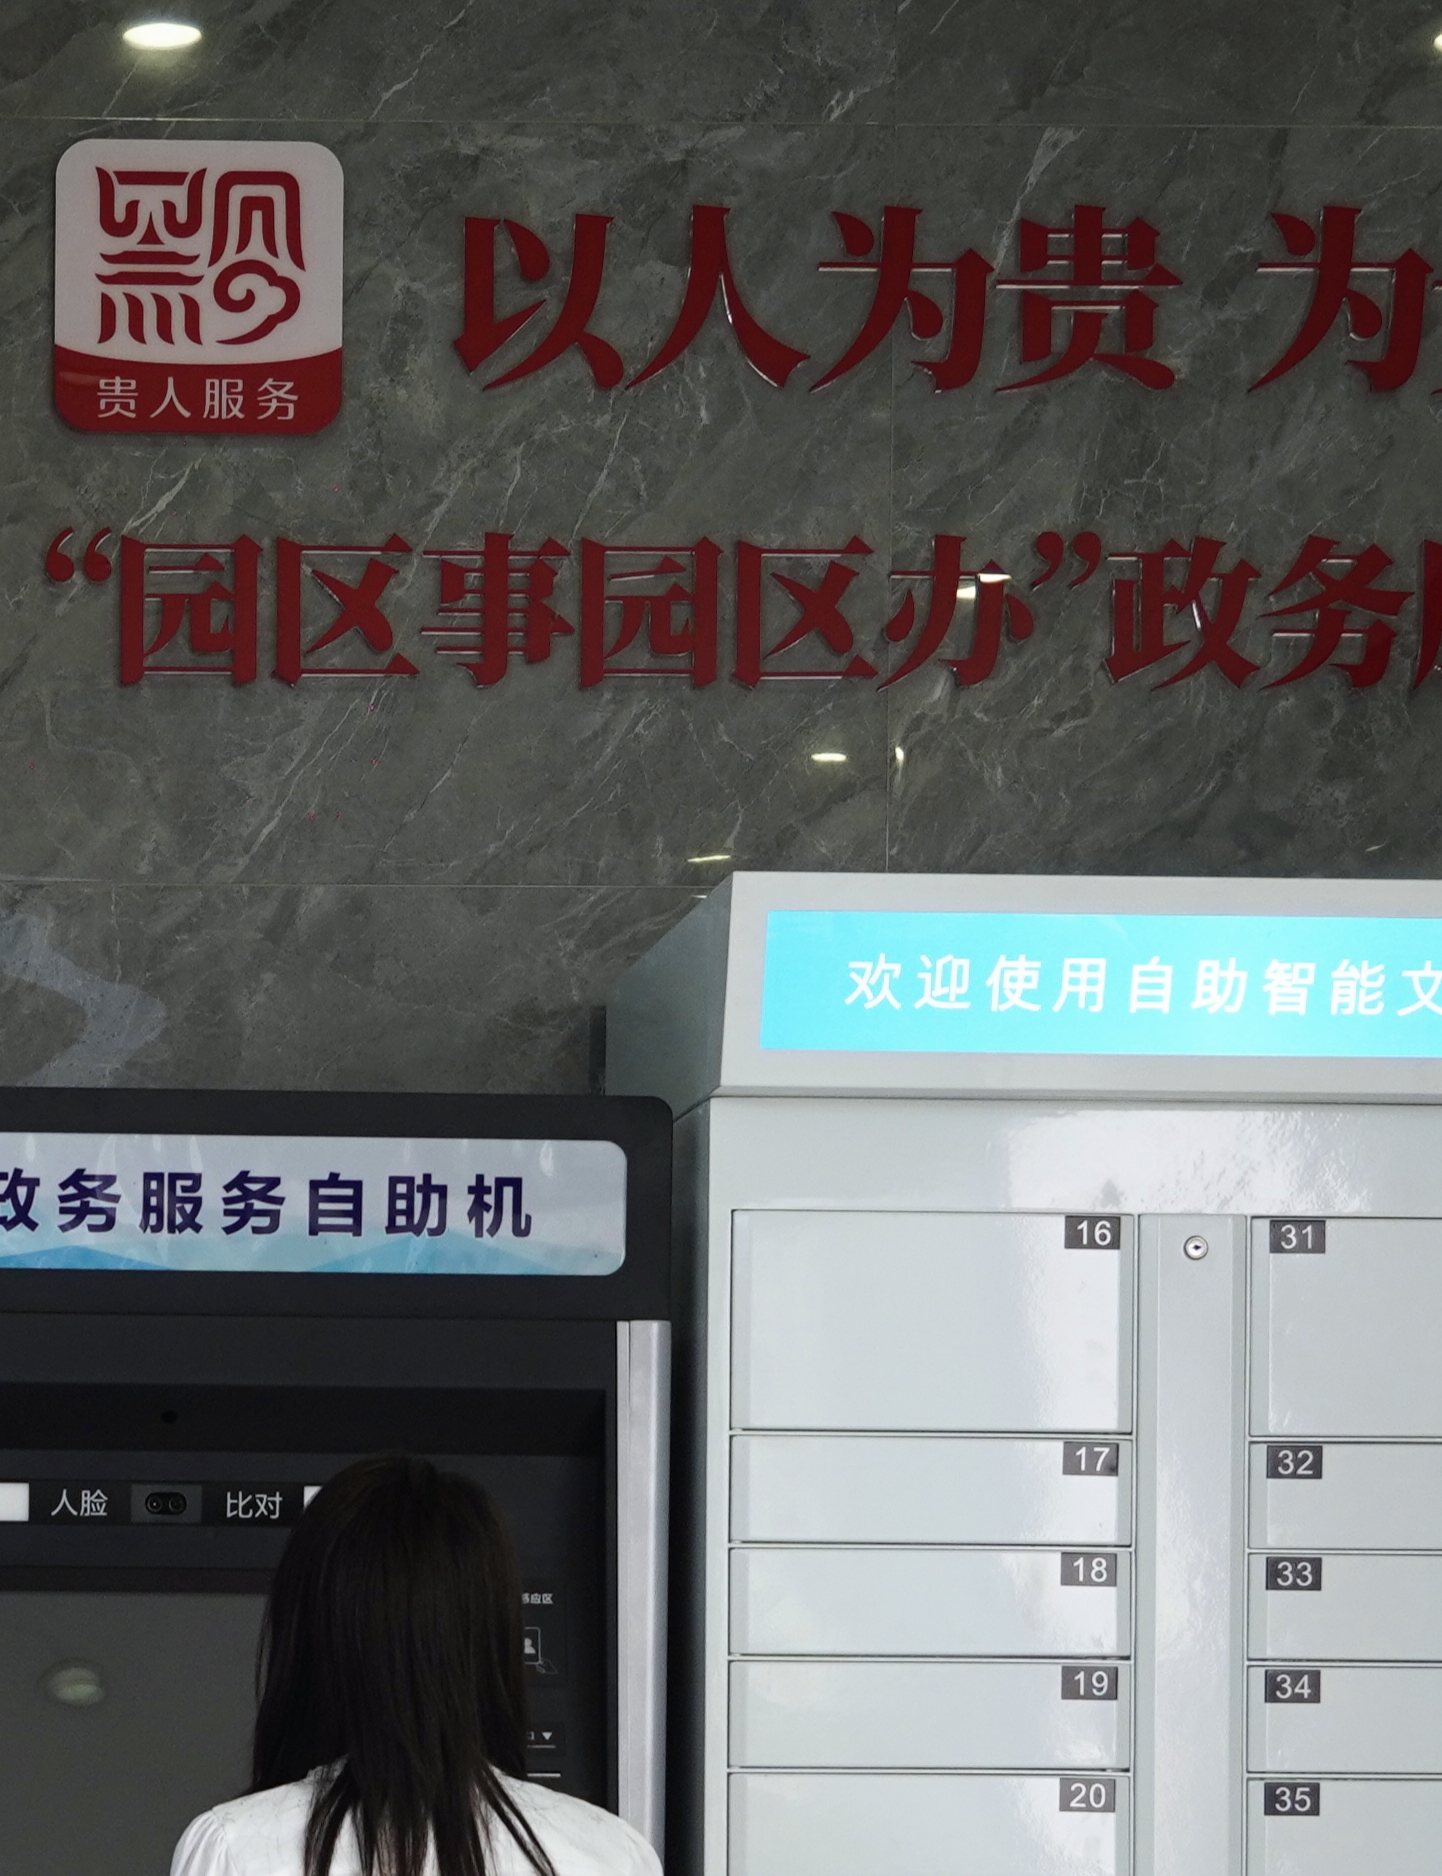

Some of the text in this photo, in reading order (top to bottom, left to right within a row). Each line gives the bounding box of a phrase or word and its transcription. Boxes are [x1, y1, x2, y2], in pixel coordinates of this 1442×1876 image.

[452, 204, 1183, 394] 以人为贵
[96, 377, 300, 422] 贵人服务
[1077, 1221, 1112, 1246] 16
[1280, 1225, 1313, 1250] 31
[1075, 1446, 1110, 1472] 17
[1277, 1449, 1314, 1475] 32
[50, 1488, 108, 1518] 人脸
[225, 1490, 283, 1521] 比对
[1073, 1556, 1108, 1583] 18
[1276, 1561, 1313, 1587] 33
[1074, 1670, 1109, 1696] 19
[1275, 1673, 1312, 1699] 34
[1069, 1782, 1106, 1809] 20
[1275, 1786, 1312, 1812] 35
